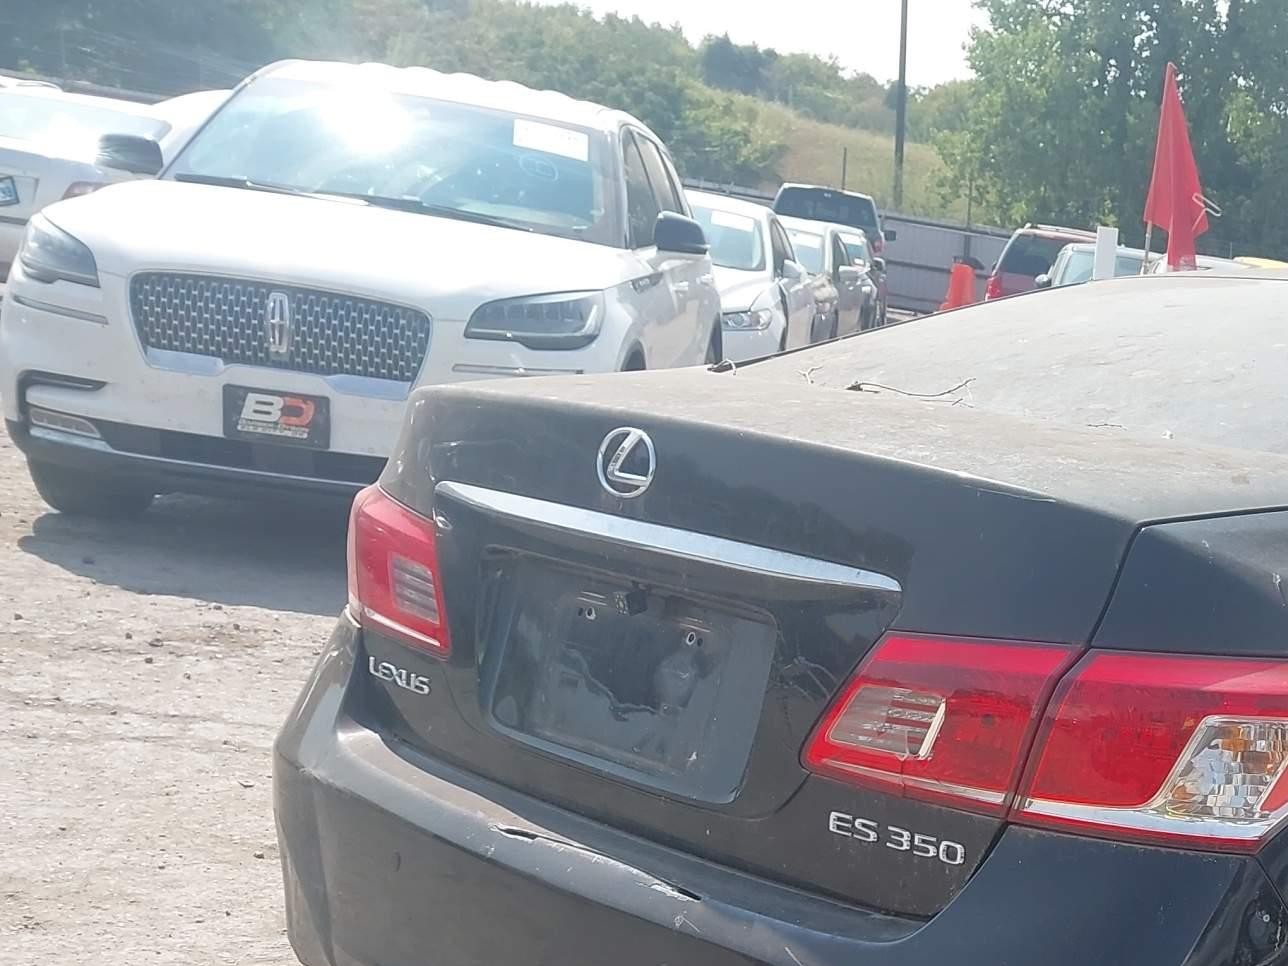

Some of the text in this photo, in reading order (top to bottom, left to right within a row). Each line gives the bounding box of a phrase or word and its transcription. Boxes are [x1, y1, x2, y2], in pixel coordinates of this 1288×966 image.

[368, 656, 430, 694] LEXUS
[829, 811, 965, 865] ES 350
